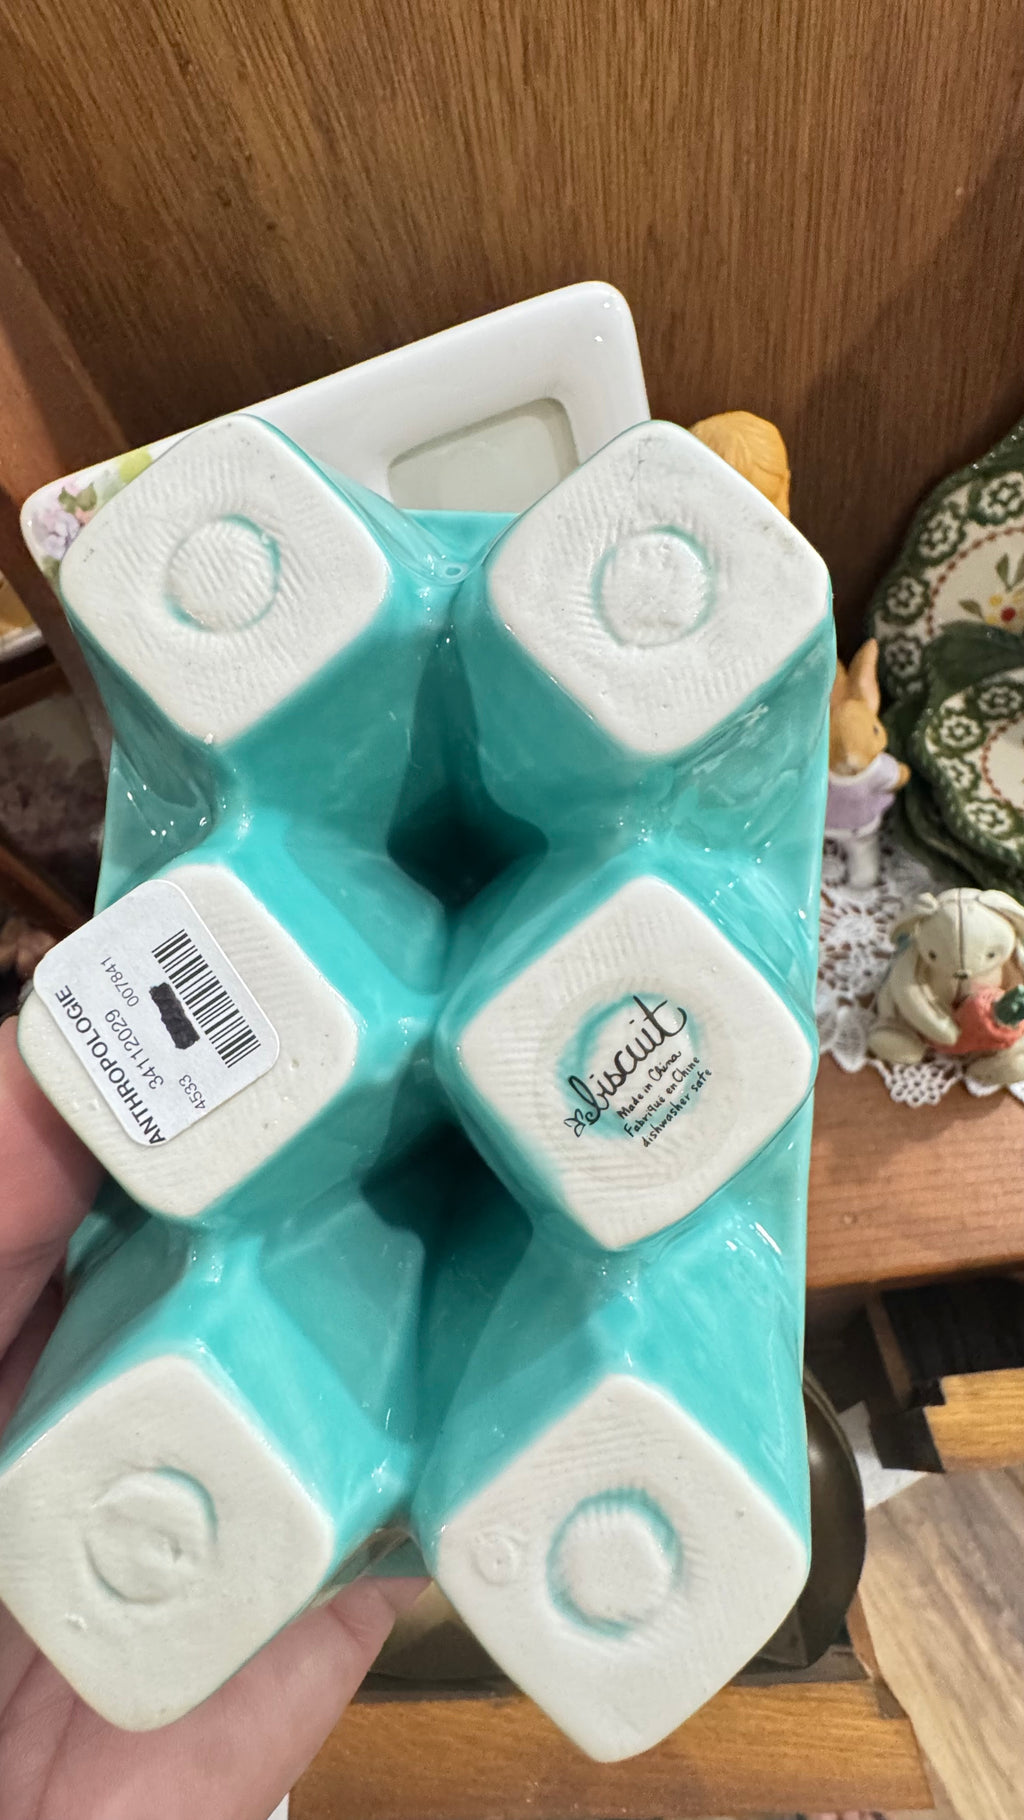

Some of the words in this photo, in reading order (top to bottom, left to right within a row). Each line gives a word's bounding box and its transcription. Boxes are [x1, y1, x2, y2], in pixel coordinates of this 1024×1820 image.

[100, 956, 139, 1007] 007841
[54, 985, 166, 1145] ANTHROPOLOGIE
[105, 1009, 164, 1090] 34112029
[568, 995, 687, 1125] biscuit
[648, 1051, 682, 1081] China
[178, 1074, 206, 1110] 4533
[616, 1093, 644, 1119] Made
[624, 1095, 665, 1137] Fabriqué
[666, 1081, 678, 1094] en
[672, 1056, 700, 1083] Chine
[642, 1093, 691, 1148] dishwasher
[691, 1069, 712, 1092] safe
[644, 1083, 653, 1094] in
